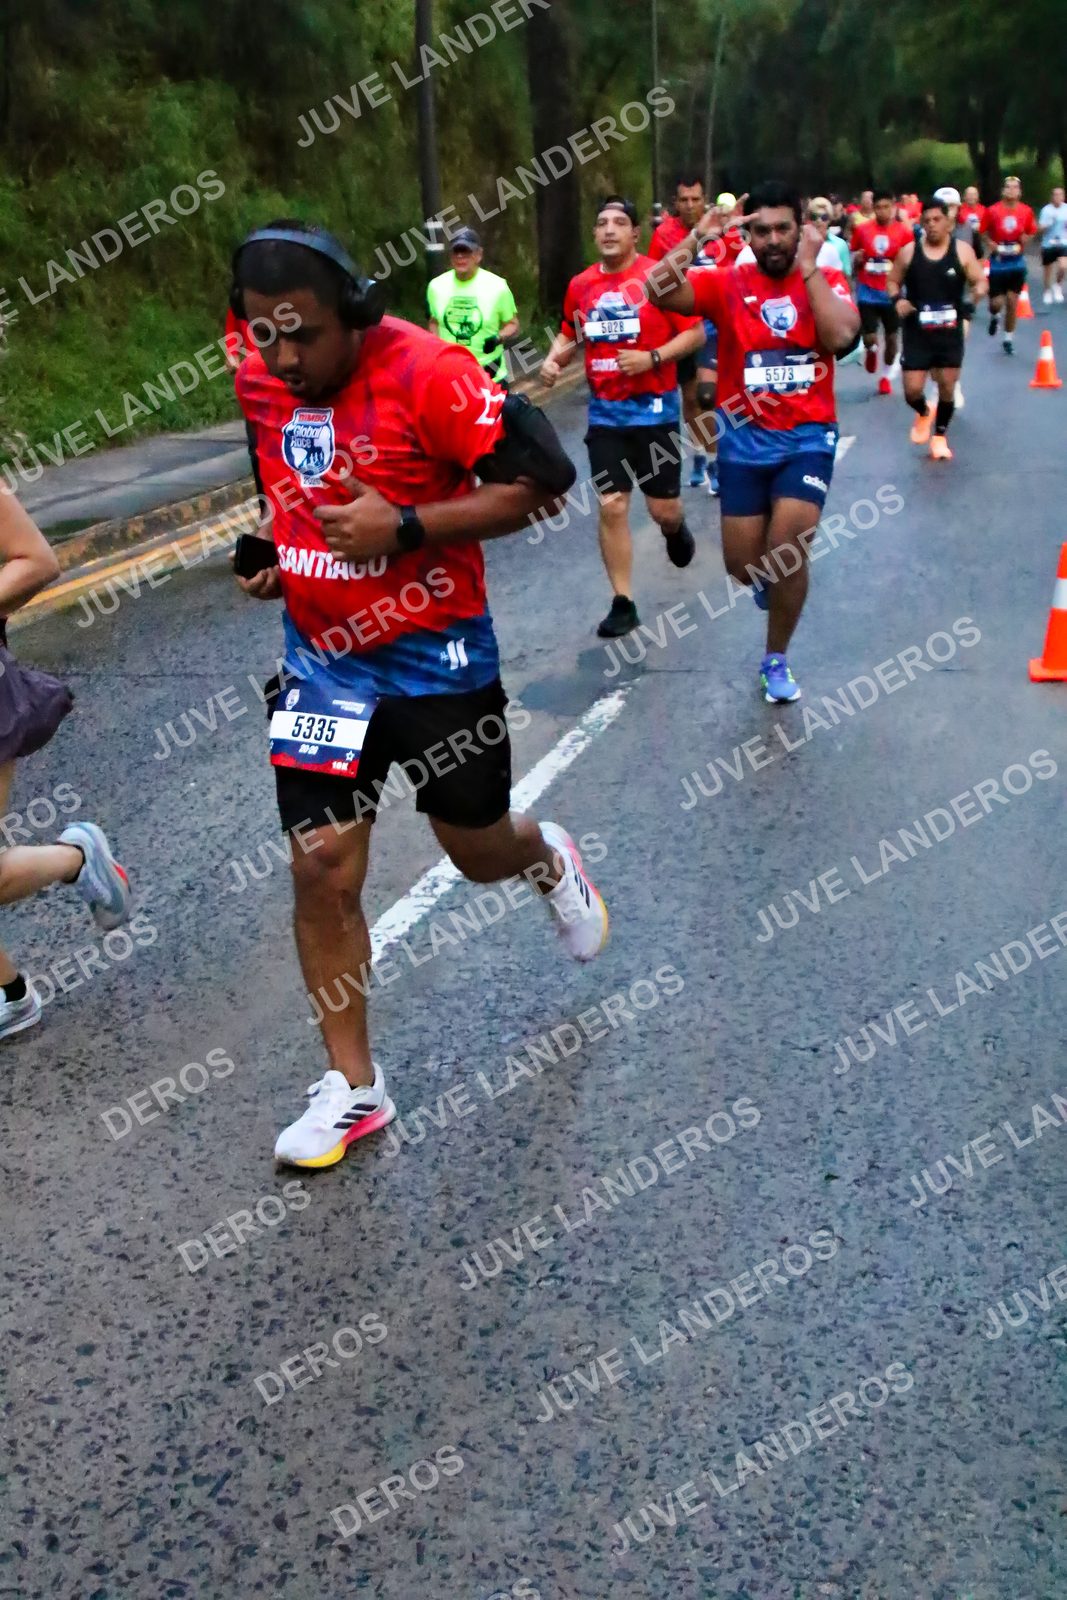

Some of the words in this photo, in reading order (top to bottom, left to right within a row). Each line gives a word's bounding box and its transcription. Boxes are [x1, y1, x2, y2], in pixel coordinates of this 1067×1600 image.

[601, 321, 625, 334] 5028
[765, 367, 794, 382] 5573
[277, 544, 388, 581] SANTIAGO
[291, 714, 339, 743] 5335
